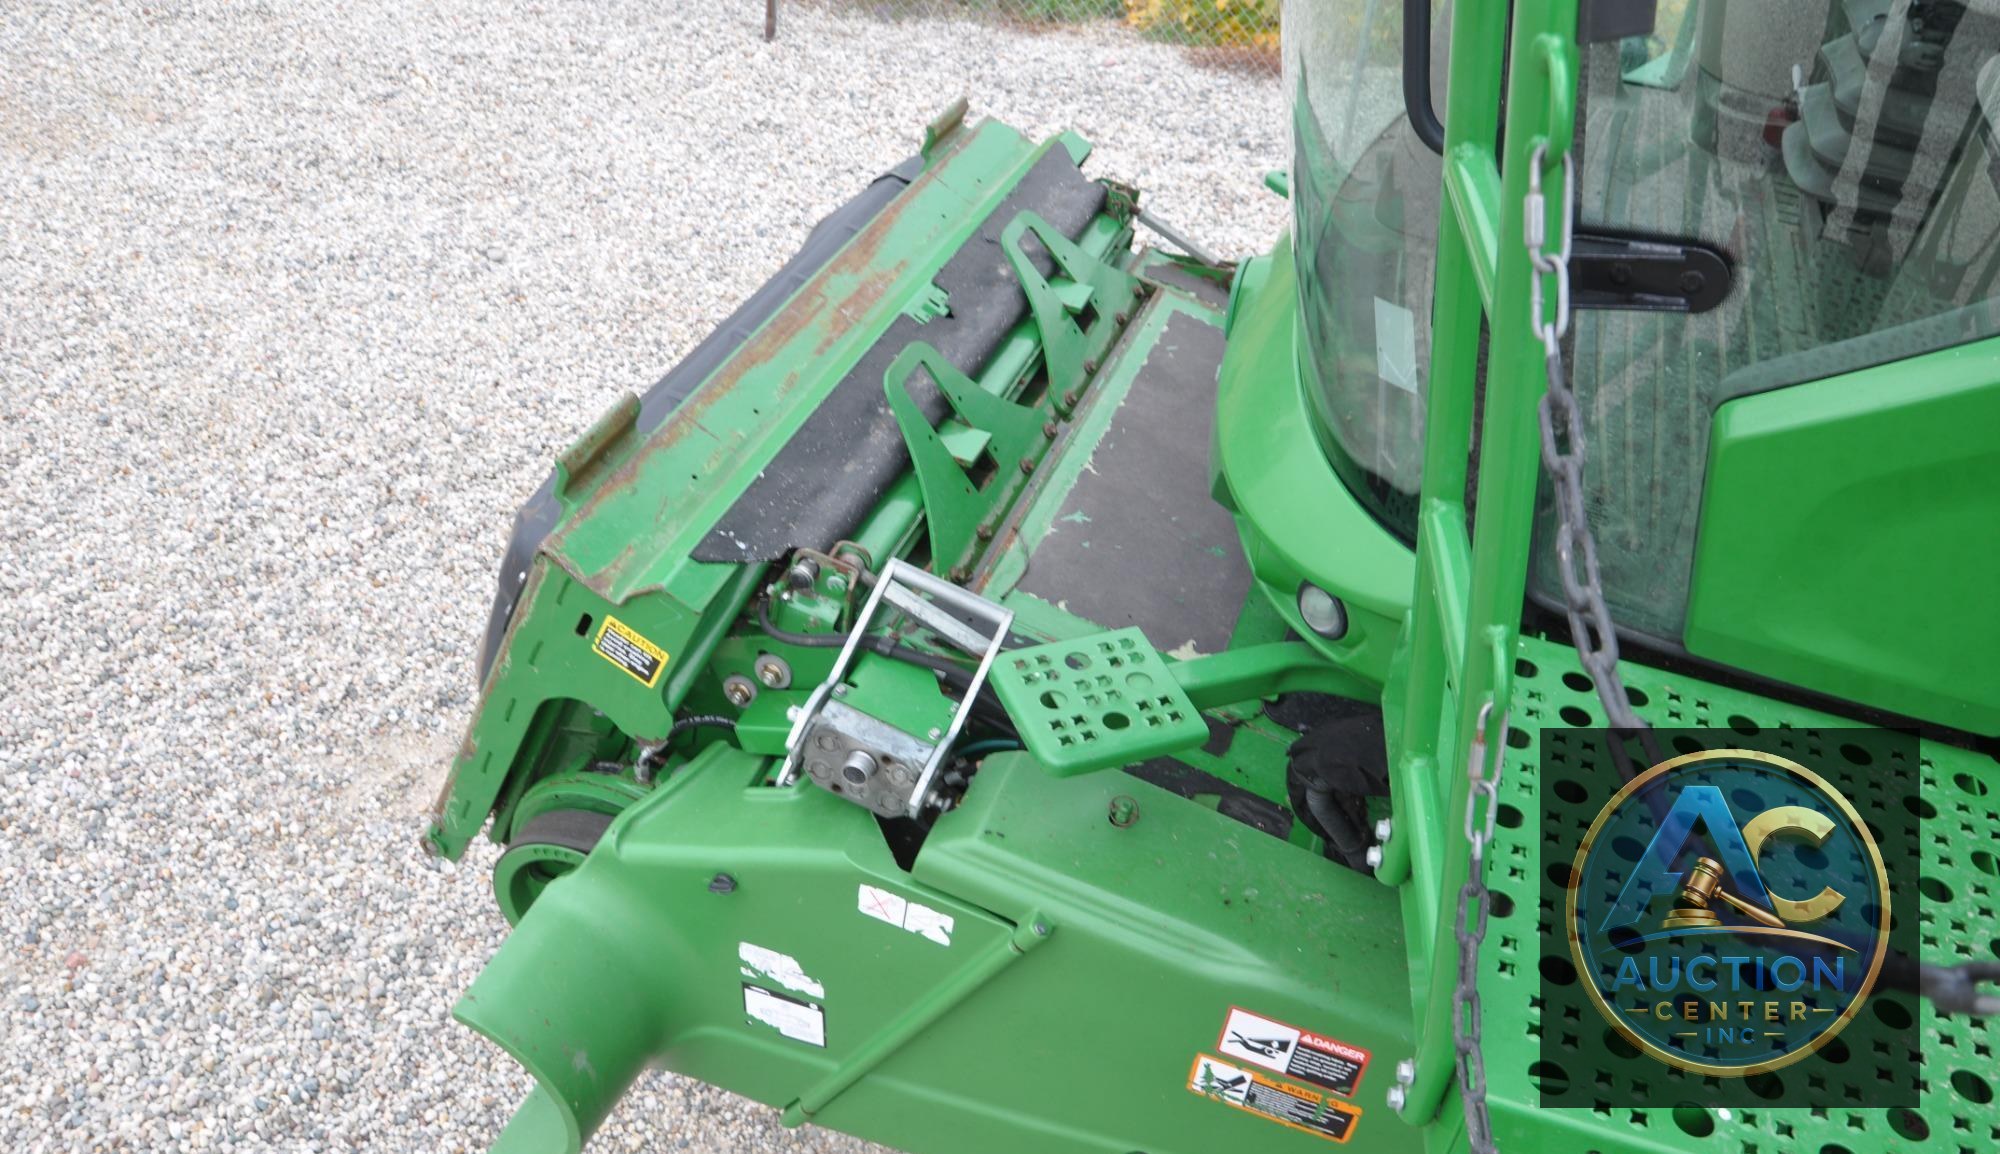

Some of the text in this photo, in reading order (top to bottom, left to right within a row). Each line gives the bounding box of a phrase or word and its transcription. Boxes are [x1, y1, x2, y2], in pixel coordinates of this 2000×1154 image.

[617, 625, 664, 659] CAUTION
[1314, 1037, 1365, 1062] DANGER
[1287, 1086, 1339, 1107] WARNG
